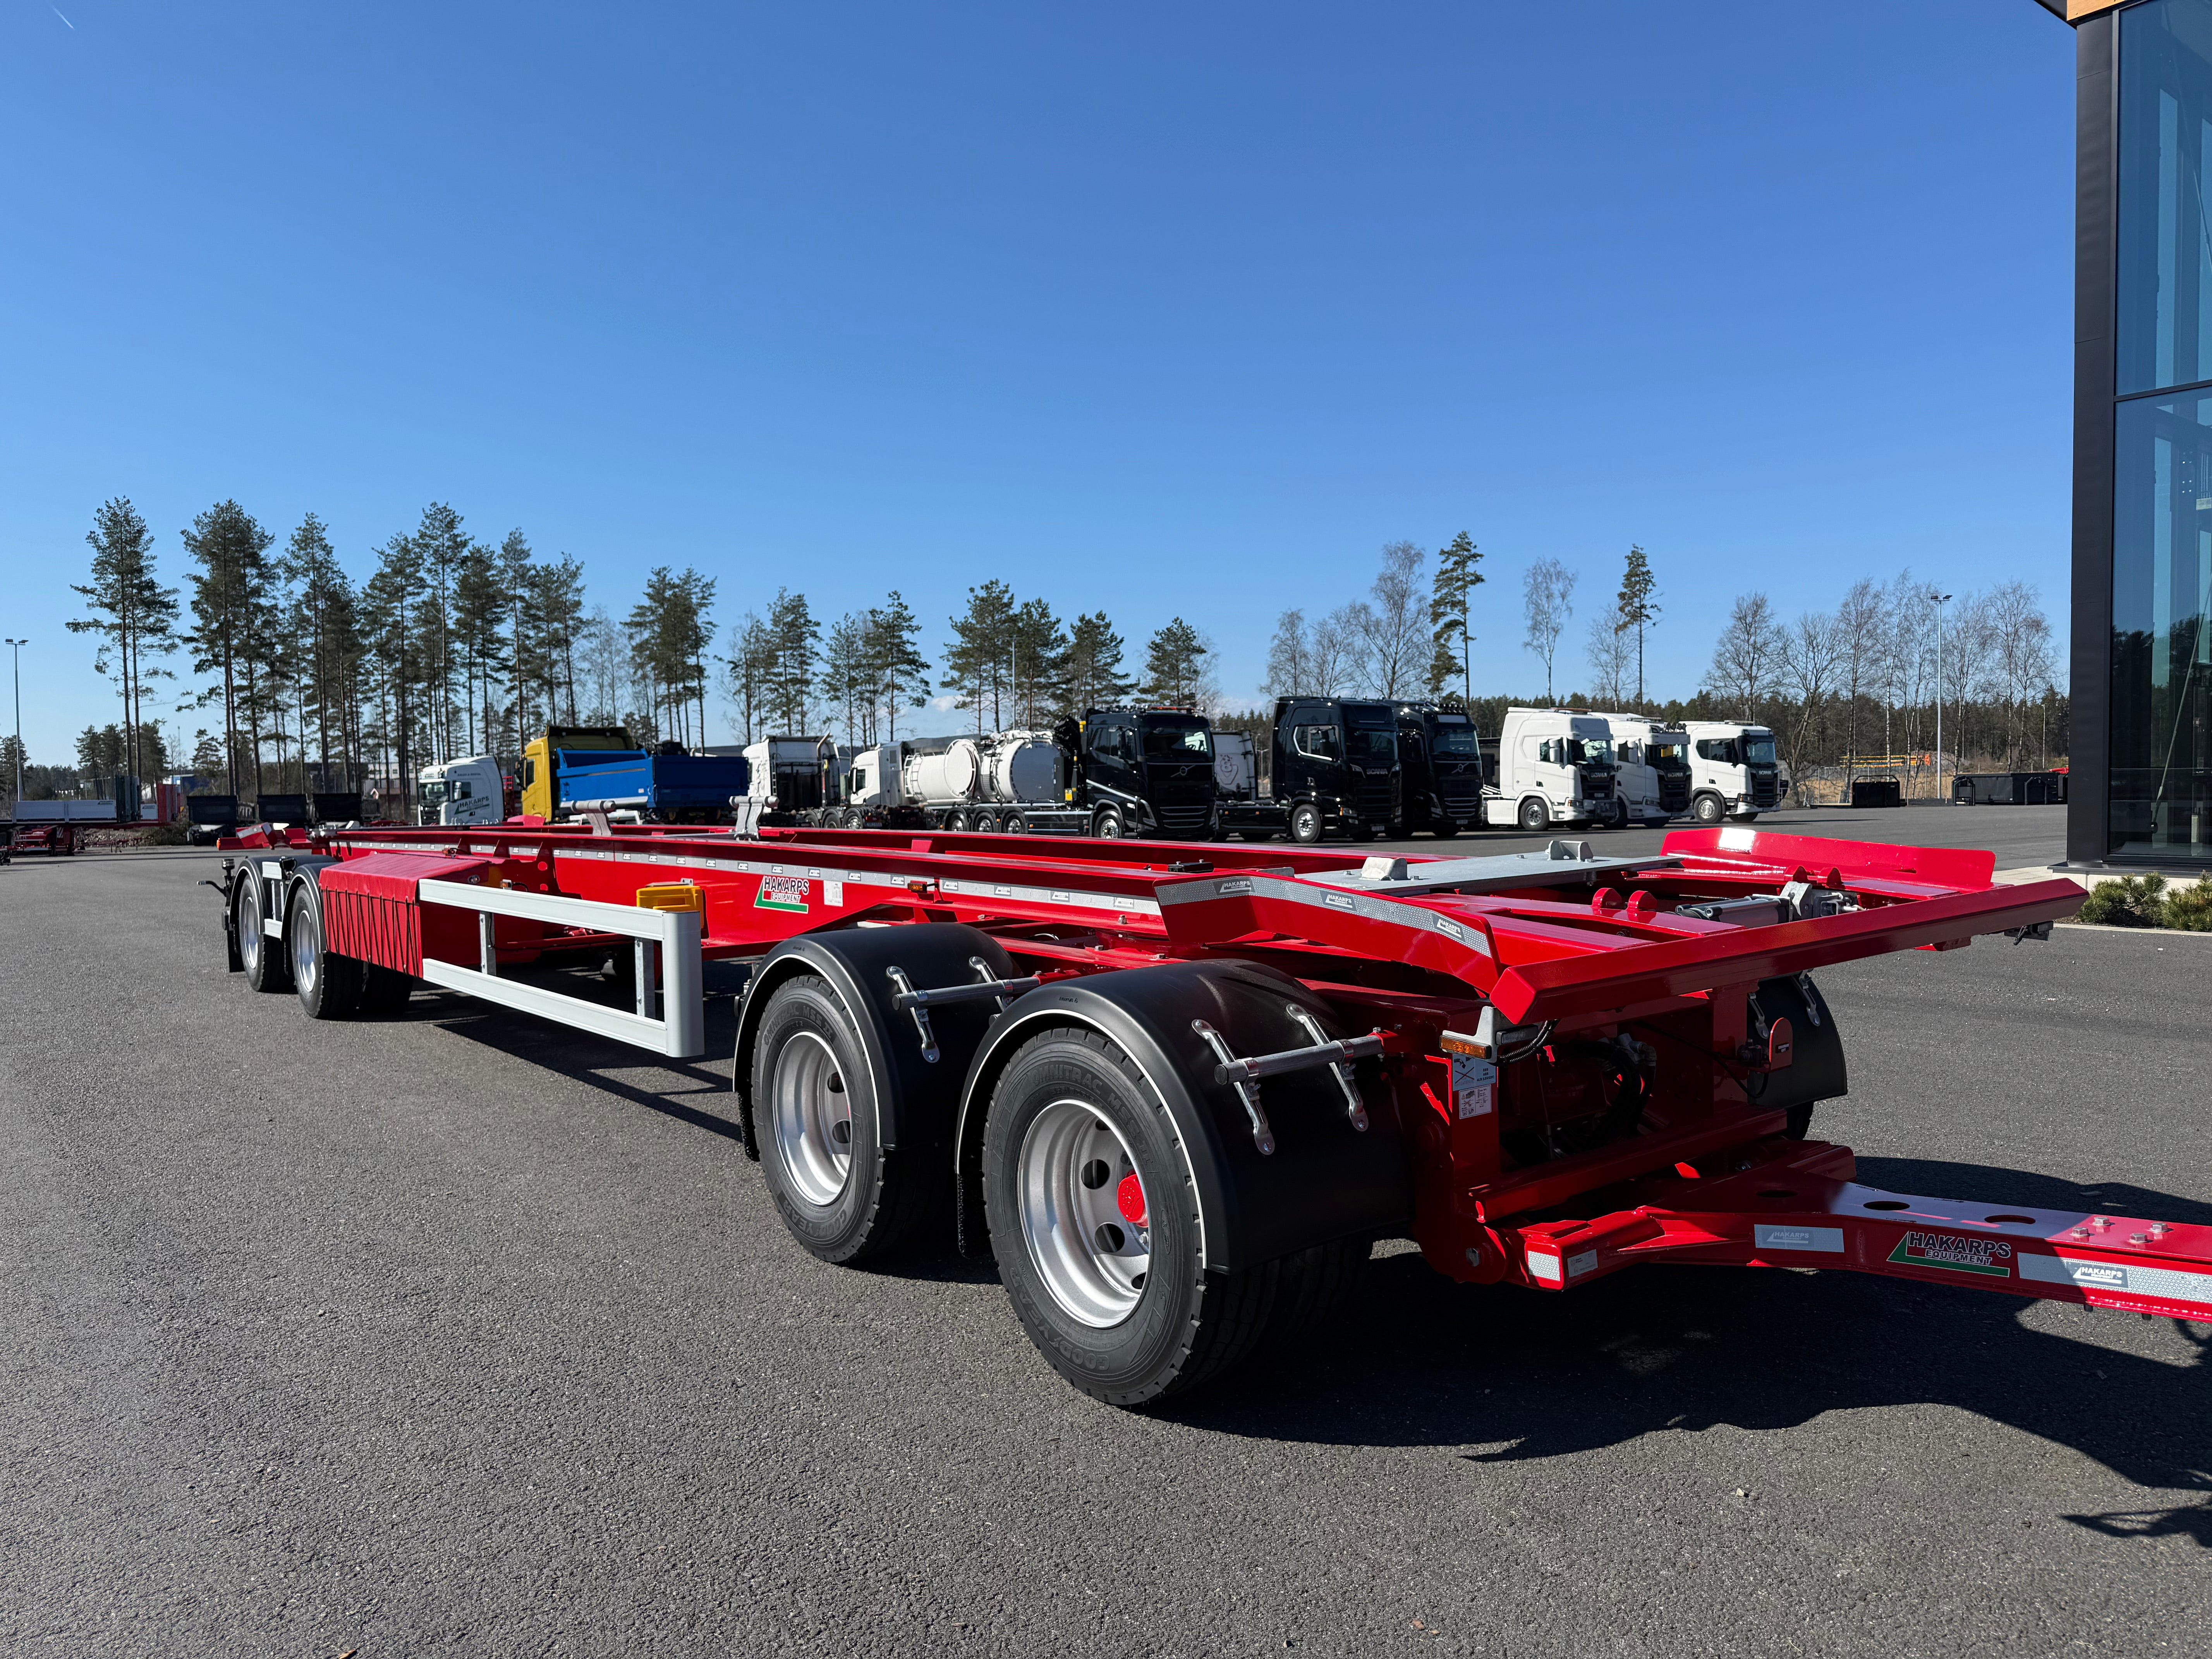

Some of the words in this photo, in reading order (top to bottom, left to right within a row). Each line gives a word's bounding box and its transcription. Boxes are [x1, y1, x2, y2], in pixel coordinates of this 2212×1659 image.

[459, 795, 489, 808] HAKARPS
[764, 875, 809, 895] HAKARPS
[771, 892, 801, 903] EQUIPMENT
[1328, 894, 1352, 903] HAKARPS
[1439, 919, 1461, 933] HAKARPS
[1030, 1065, 1103, 1094] OMNITRAC
[1908, 1231, 2011, 1258] HAKARPS
[1925, 1249, 1993, 1265] EQUIPMENT
[2081, 1266, 2123, 1278] HAKARPS
[1010, 1267, 1110, 1370] GOODYEAR
